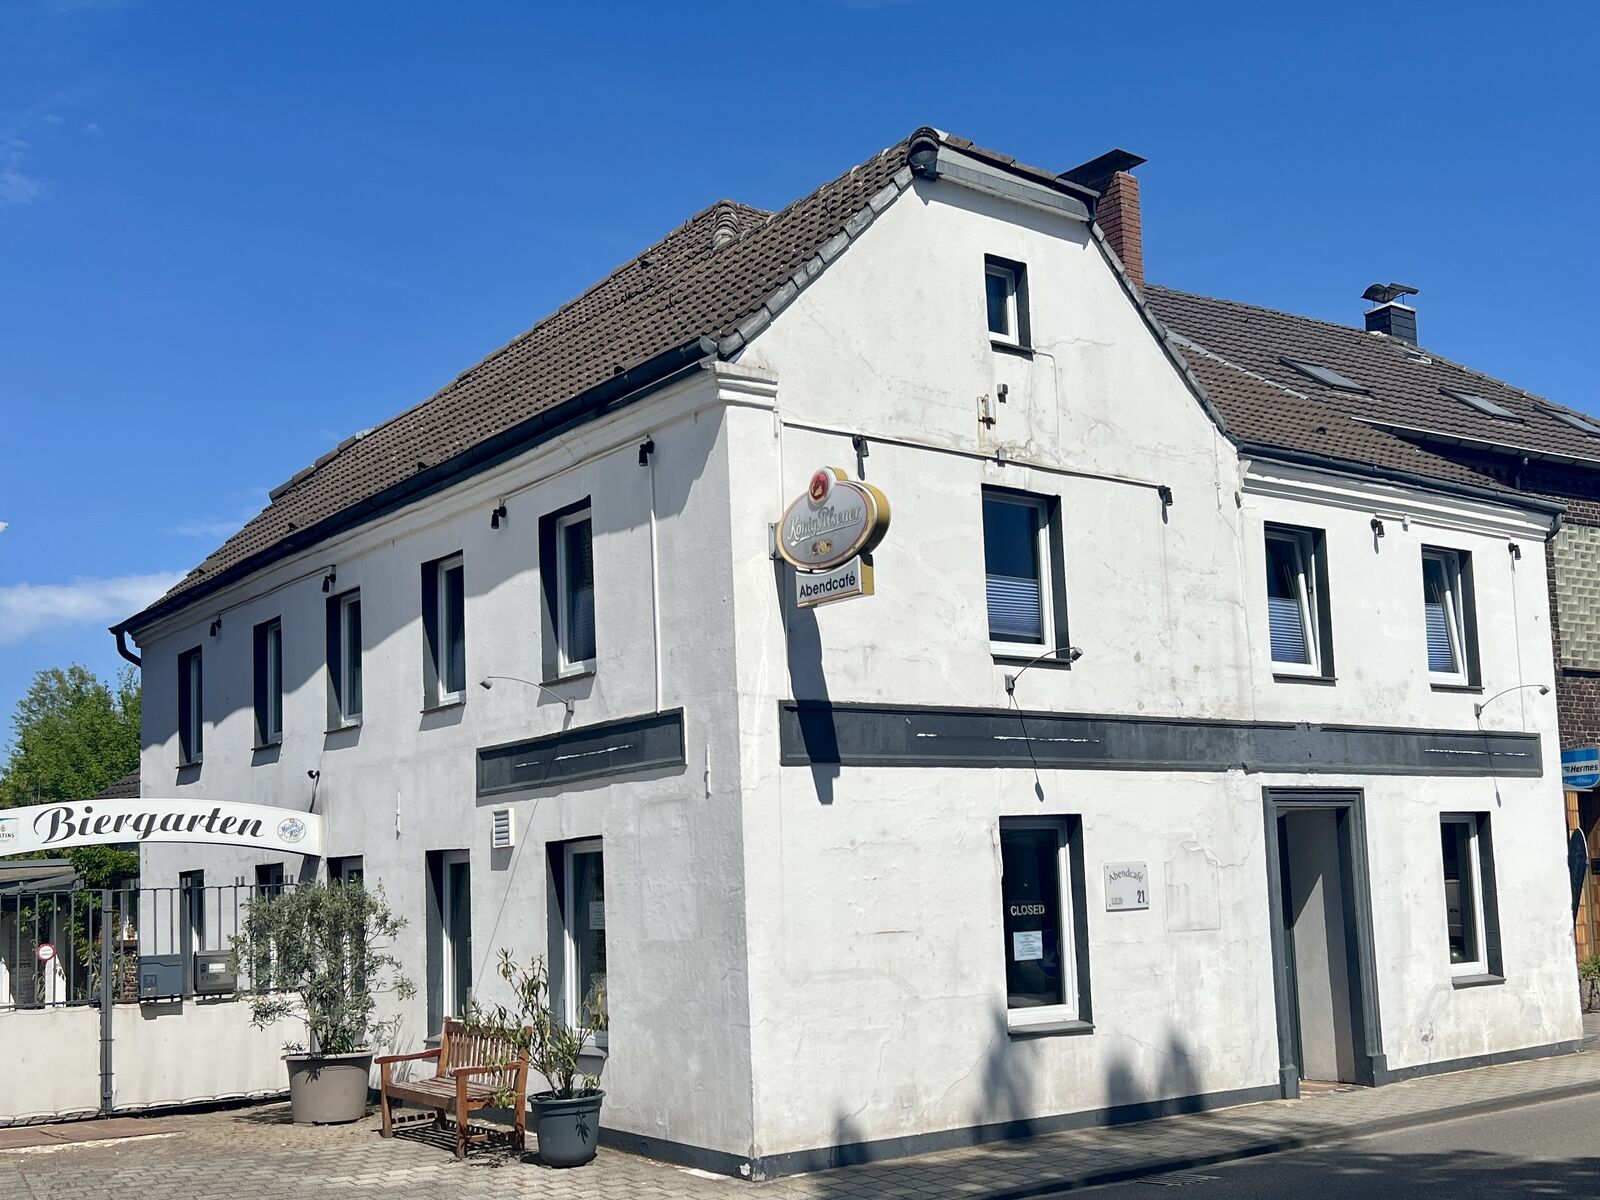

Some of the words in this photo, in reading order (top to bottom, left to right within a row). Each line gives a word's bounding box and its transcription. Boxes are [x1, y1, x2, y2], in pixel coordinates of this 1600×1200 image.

[799, 571, 856, 599] Abendcafé
[1570, 764, 1599, 773] Hermes
[33, 805, 264, 844] Biergarten
[1136, 889, 1145, 904] 21
[1010, 904, 1045, 917] CLOSED
